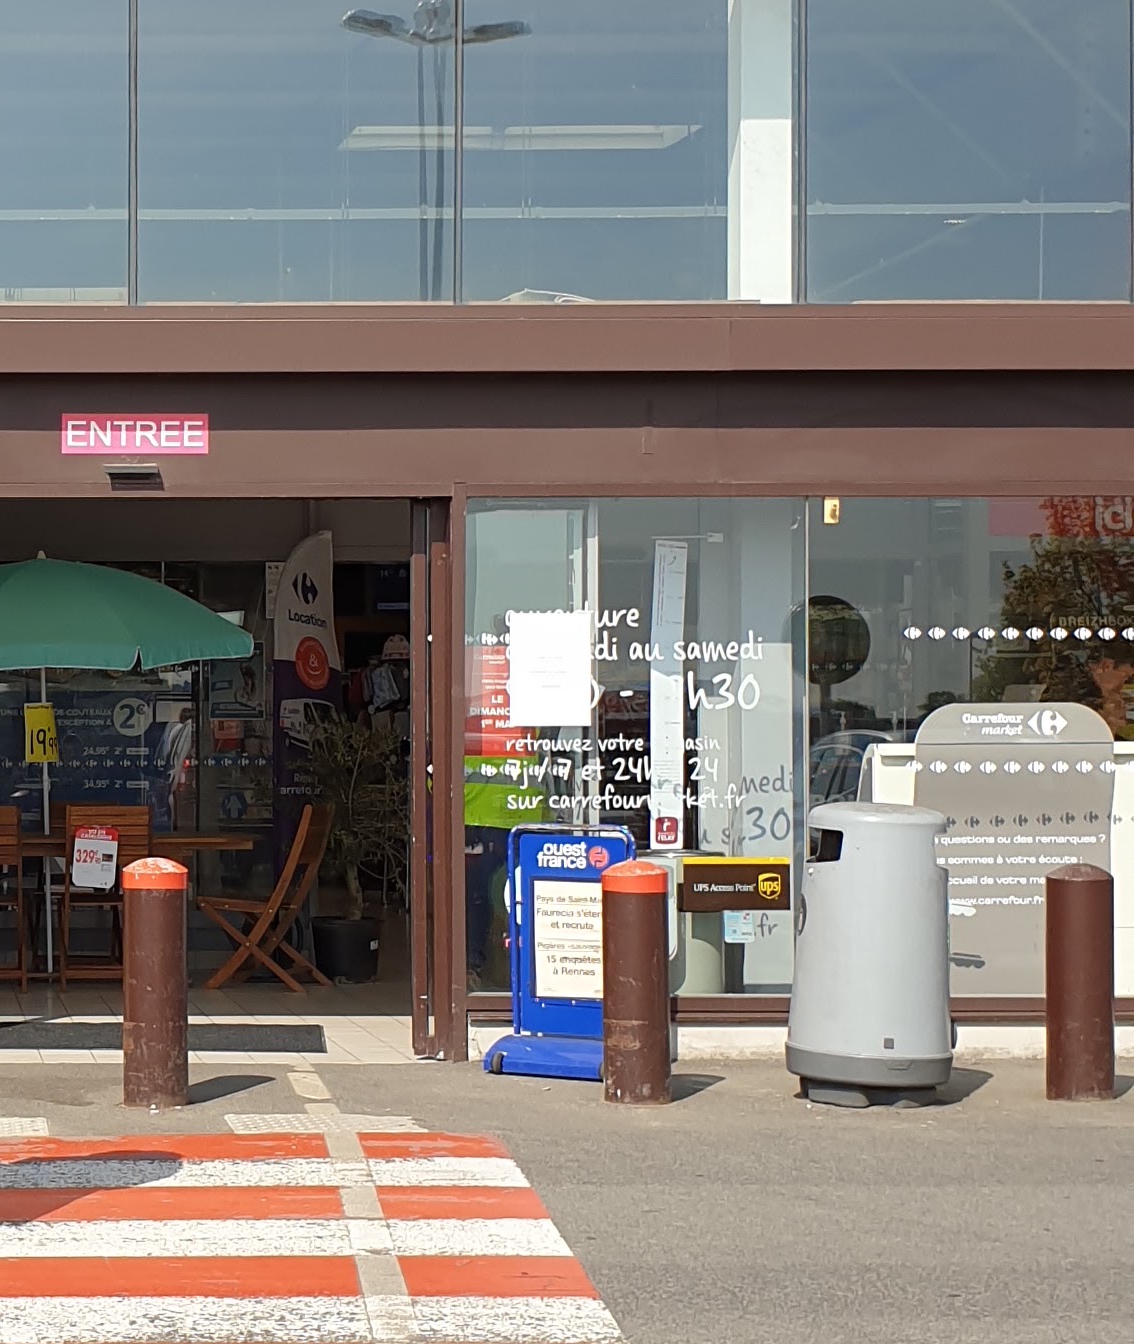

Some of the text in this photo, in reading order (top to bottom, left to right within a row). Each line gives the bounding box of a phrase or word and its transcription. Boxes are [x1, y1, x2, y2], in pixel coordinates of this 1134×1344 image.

[66, 420, 204, 447] ENTREE
[288, 608, 327, 628] Location
[629, 641, 665, 661] au
[673, 630, 764, 663] samedi
[491, 695, 504, 704] LE
[469, 707, 511, 716] DIMANC
[962, 713, 1024, 724] Carrefour
[981, 724, 1023, 736] market
[506, 733, 593, 752] retrouvez
[598, 732, 644, 752] votre
[581, 760, 605, 781] et
[507, 794, 544, 809] sur
[940, 834, 995, 846] questions
[997, 836, 1010, 844] ou
[1013, 834, 1034, 844] des
[1035, 835, 1097, 845] remarques
[542, 841, 587, 856] ouest
[536, 851, 587, 869] france
[947, 856, 994, 864] sommes
[1005, 855, 1036, 864] votre
[1038, 854, 1078, 864] écoute
[980, 875, 993, 885] de
[996, 875, 1026, 885] votre
[694, 883, 709, 892] UPS
[710, 883, 734, 892] Access
[760, 882, 778, 896] ups
[550, 921, 594, 930] et recrute
[547, 955, 557, 963] 15
[561, 966, 596, 976] Rennes
